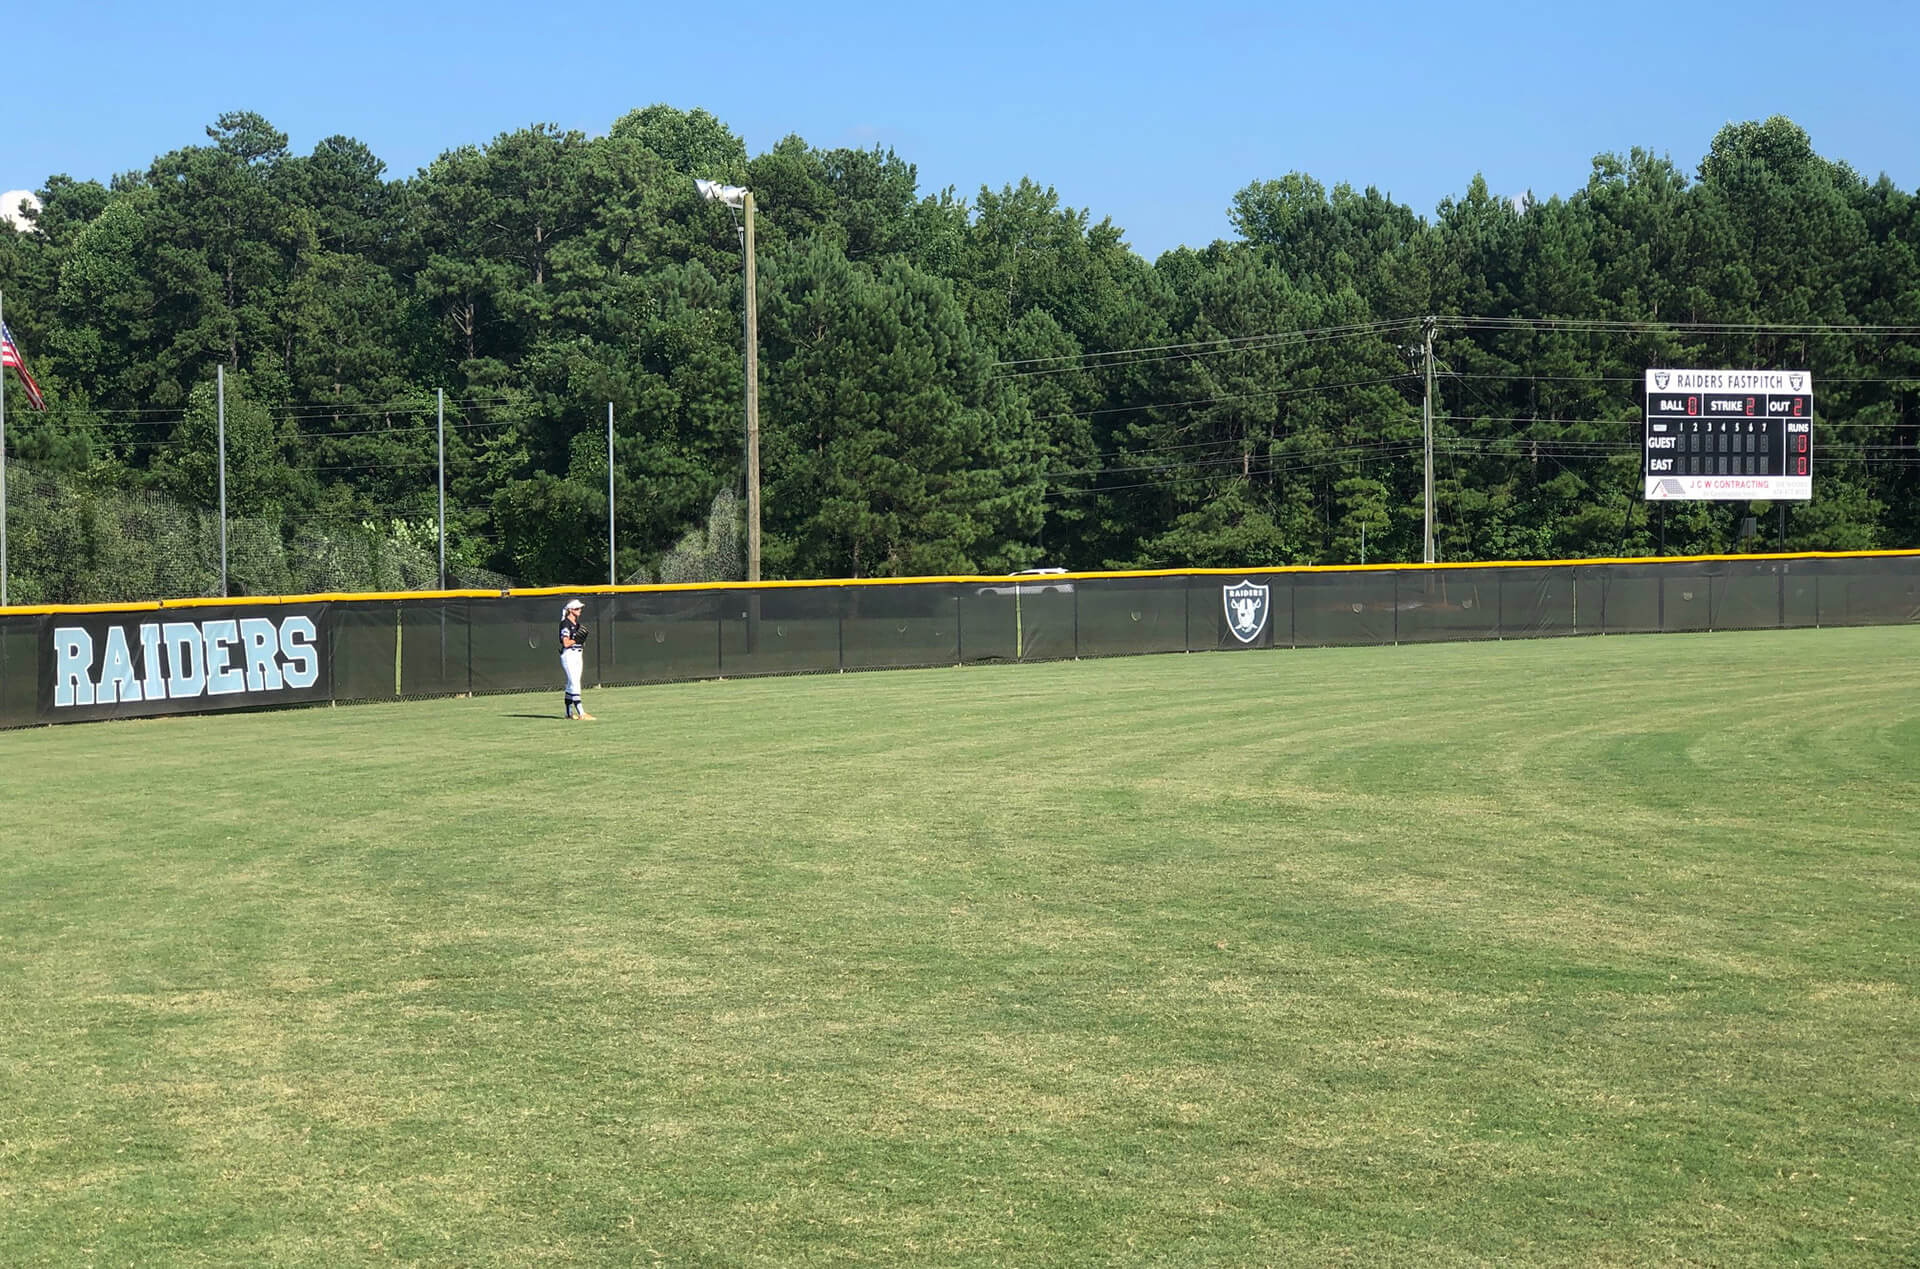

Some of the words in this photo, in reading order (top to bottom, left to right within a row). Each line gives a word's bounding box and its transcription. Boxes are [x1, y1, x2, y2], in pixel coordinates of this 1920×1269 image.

[1677, 374, 1723, 388] RAIDERS
[1728, 375, 1783, 389] FASTPITCH
[1660, 400, 1684, 411] BALL
[1687, 396, 1697, 416] 0
[1711, 401, 1743, 411] STRIKE
[1746, 397, 1755, 416] 2
[1769, 401, 1791, 412] OUT
[1794, 398, 1803, 416] 2
[1679, 423, 1683, 432] 1
[1693, 423, 1698, 432] 2
[1707, 423, 1712, 432] 3
[1721, 423, 1726, 432] 4
[1735, 423, 1740, 432] 5
[1748, 423, 1753, 432] 6
[1762, 423, 1767, 432] 7
[1788, 423, 1809, 432] RUNS
[1648, 437, 1676, 449] GUEST
[1798, 434, 1807, 453] 0
[1650, 459, 1673, 471] EAST
[1798, 456, 1807, 475] 0
[1690, 480, 1695, 488] J
[1697, 480, 1702, 488] C
[1704, 480, 1712, 488] W
[1714, 480, 1769, 489] CONTRACTING
[54, 615, 319, 707] RAIDERS
